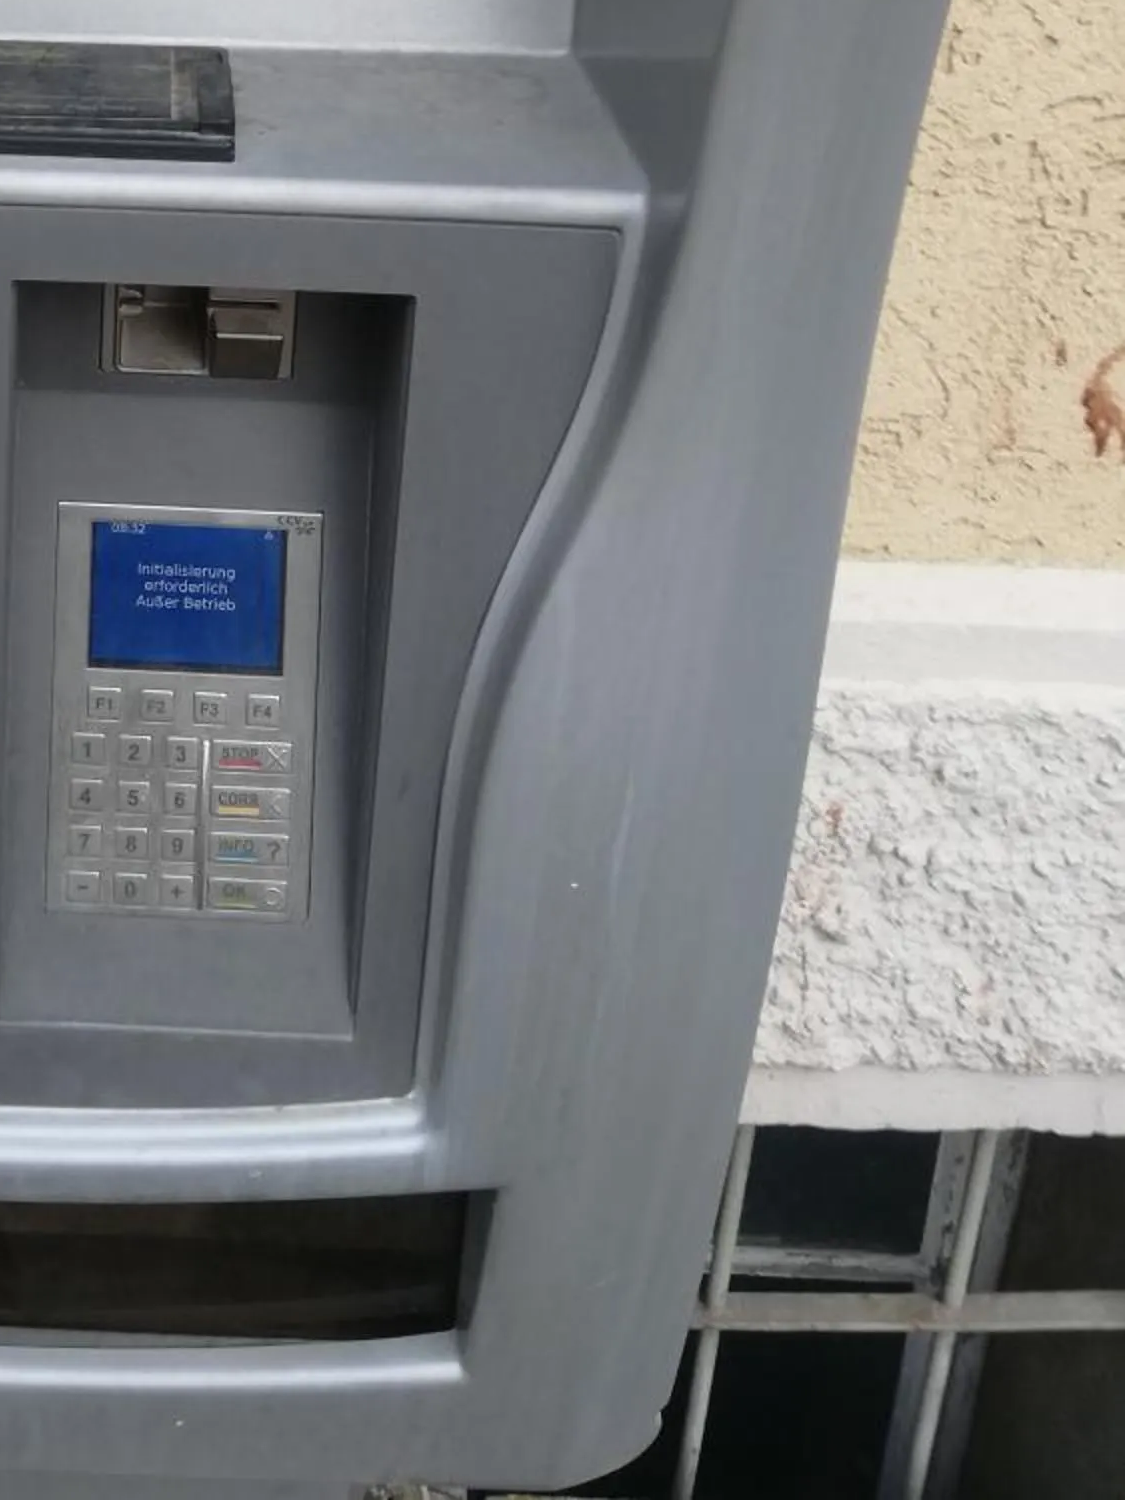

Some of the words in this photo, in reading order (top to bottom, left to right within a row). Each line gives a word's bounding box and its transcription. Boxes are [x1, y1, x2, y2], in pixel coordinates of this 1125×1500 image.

[138, 563, 236, 581] Initialisierung
[144, 580, 228, 595] erforderlich
[136, 595, 179, 609] Außer
[184, 596, 236, 611] Betrieb
[95, 698, 113, 711] F1
[146, 699, 166, 714] F2
[200, 704, 220, 718] F3
[252, 705, 272, 719] F4
[82, 742, 92, 758] 1
[128, 744, 141, 761] 2
[176, 746, 186, 762] 3
[222, 747, 260, 759] STOP
[79, 788, 91, 804] 4
[127, 790, 139, 806] 5
[174, 791, 185, 807] 6
[80, 834, 90, 849] 7
[126, 836, 137, 852] 8
[172, 838, 183, 854] 9
[125, 882, 136, 898] 0
